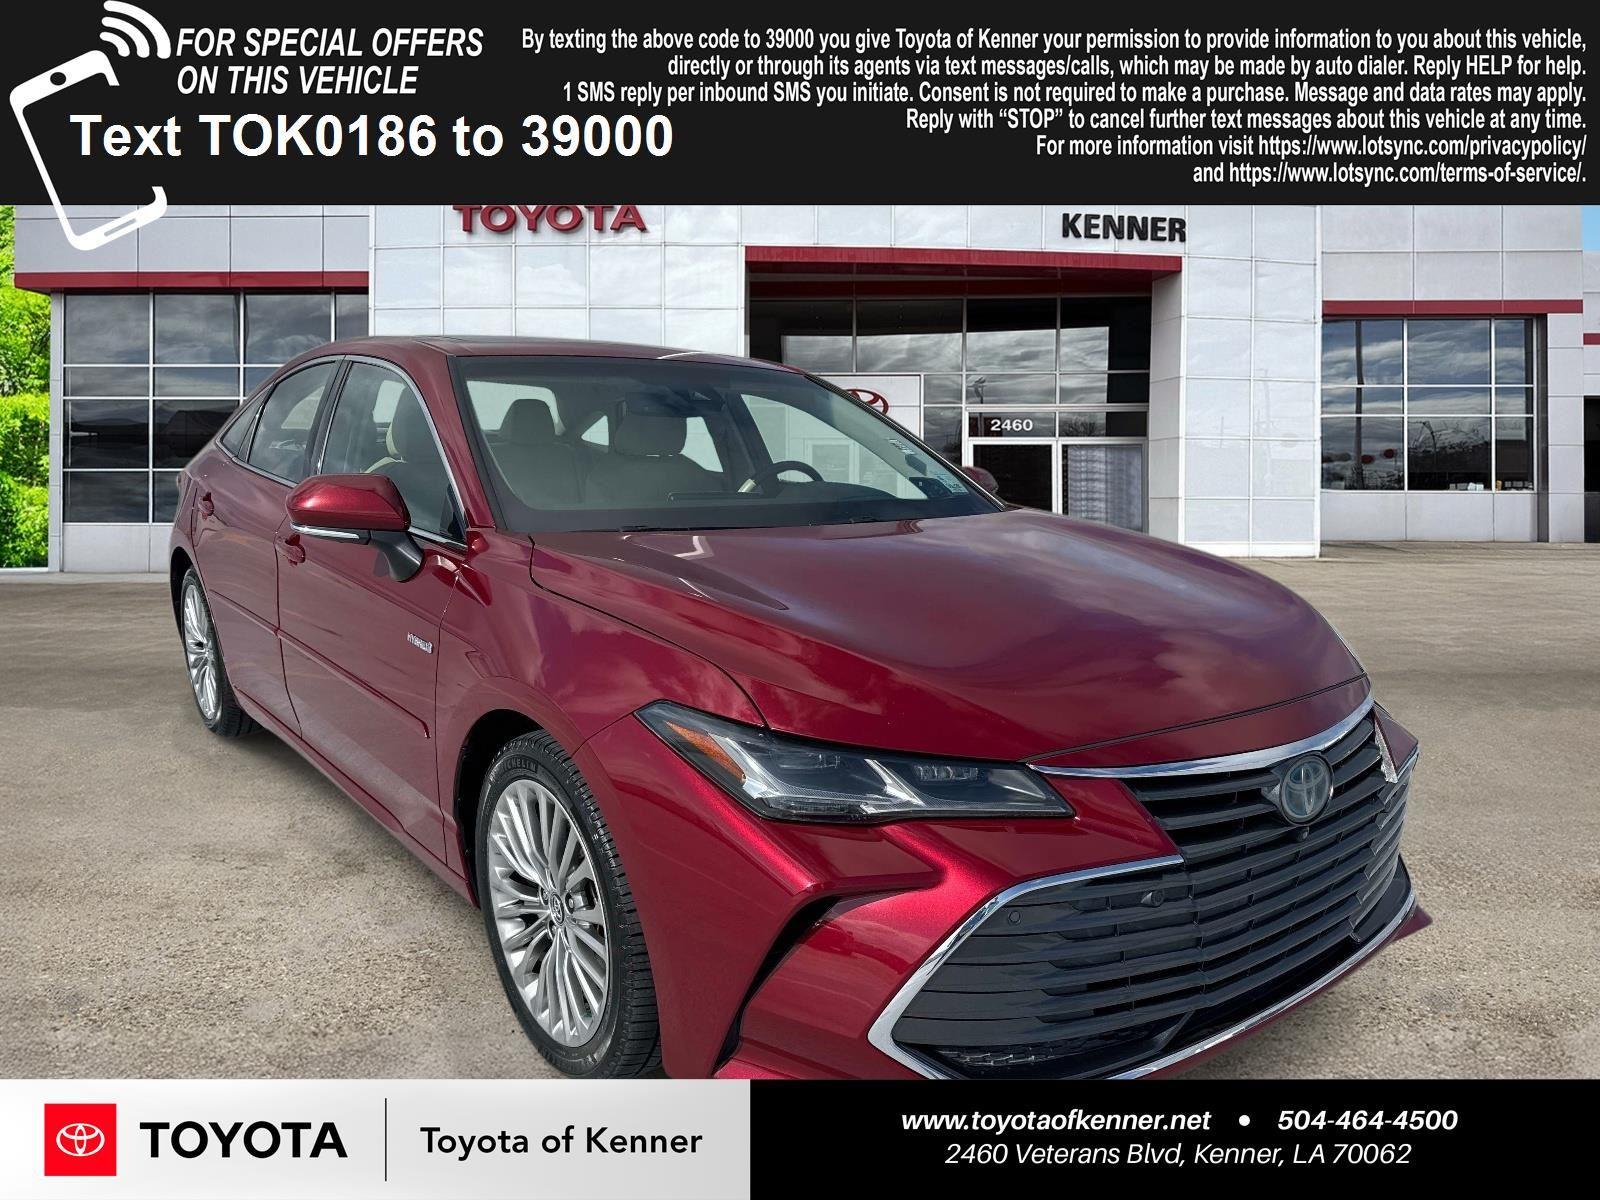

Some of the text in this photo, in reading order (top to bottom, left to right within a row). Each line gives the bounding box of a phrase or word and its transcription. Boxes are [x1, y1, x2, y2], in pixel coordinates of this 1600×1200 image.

[453, 205, 647, 233] TOYOTA
[1062, 213, 1187, 243] KENNER
[990, 419, 1033, 432] 2460
